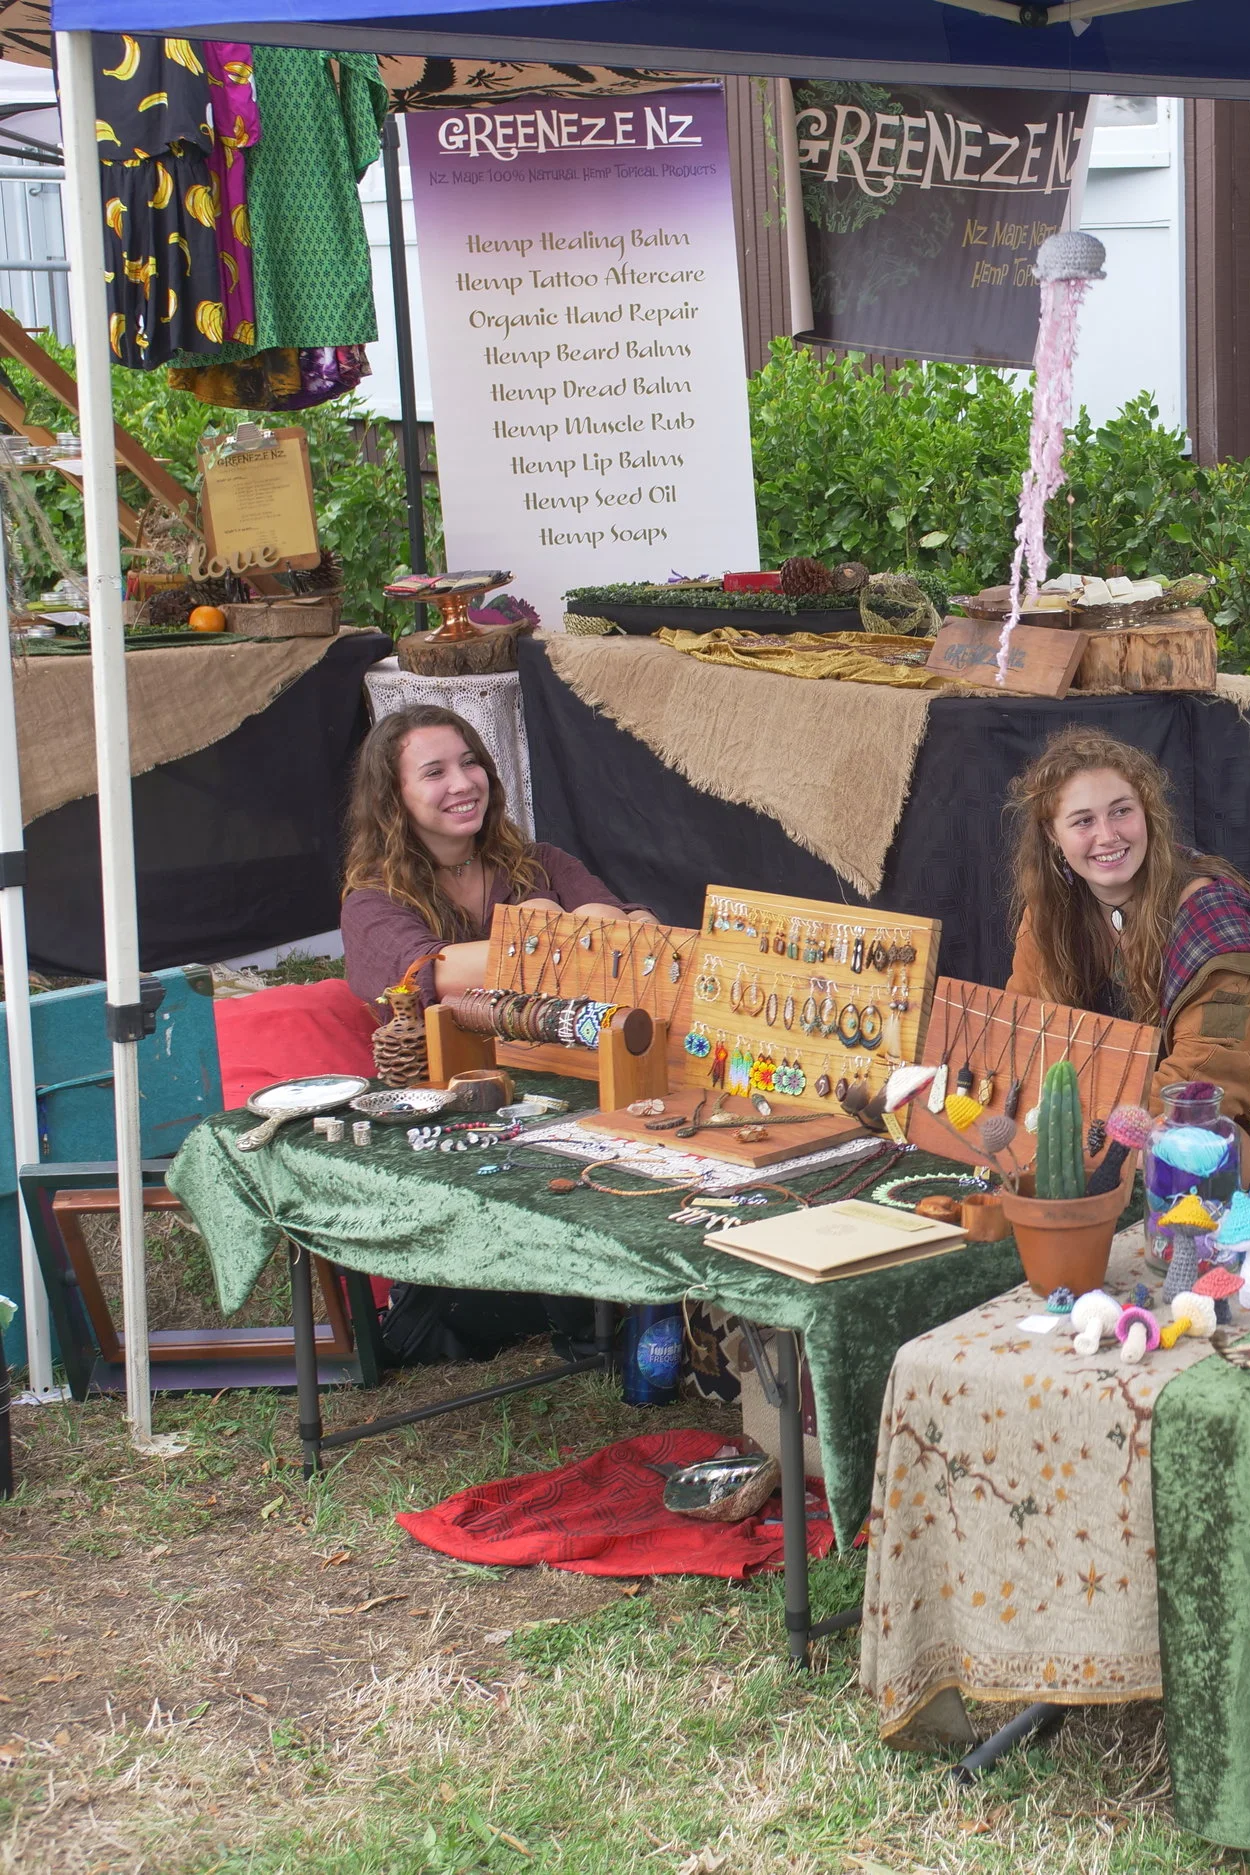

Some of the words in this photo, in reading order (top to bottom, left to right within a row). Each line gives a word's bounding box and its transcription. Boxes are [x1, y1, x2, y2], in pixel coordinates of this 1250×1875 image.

[438, 109, 636, 161] GREENEZE
[645, 107, 702, 150] NZ
[795, 104, 1048, 198] GREENEZE
[465, 235, 534, 258] Hemp
[539, 231, 626, 261] Healing
[630, 228, 691, 248] Balm
[455, 273, 523, 293] Hemp
[528, 270, 599, 290] Tattoo
[603, 262, 706, 286] Aftercare
[468, 309, 559, 340] Organic
[564, 303, 624, 325] Hand
[629, 301, 700, 327] Repair
[483, 346, 552, 369] Hemp
[556, 341, 620, 363] Beard
[625, 339, 692, 360] Balms
[489, 383, 557, 405] Hemp
[562, 377, 627, 400] Dread
[632, 376, 692, 396] Balm
[492, 420, 559, 442] Hemp
[564, 414, 646, 436] Muscle
[650, 411, 696, 432] Rub
[509, 456, 577, 478] Hemp
[582, 452, 613, 476] Lip
[618, 450, 685, 469] Balms
[522, 492, 589, 514] Hemp
[594, 487, 643, 508] Seed
[648, 485, 677, 504] Oil
[538, 528, 605, 549] Hemp
[609, 524, 668, 547] Soaps
[191, 543, 281, 582] love
